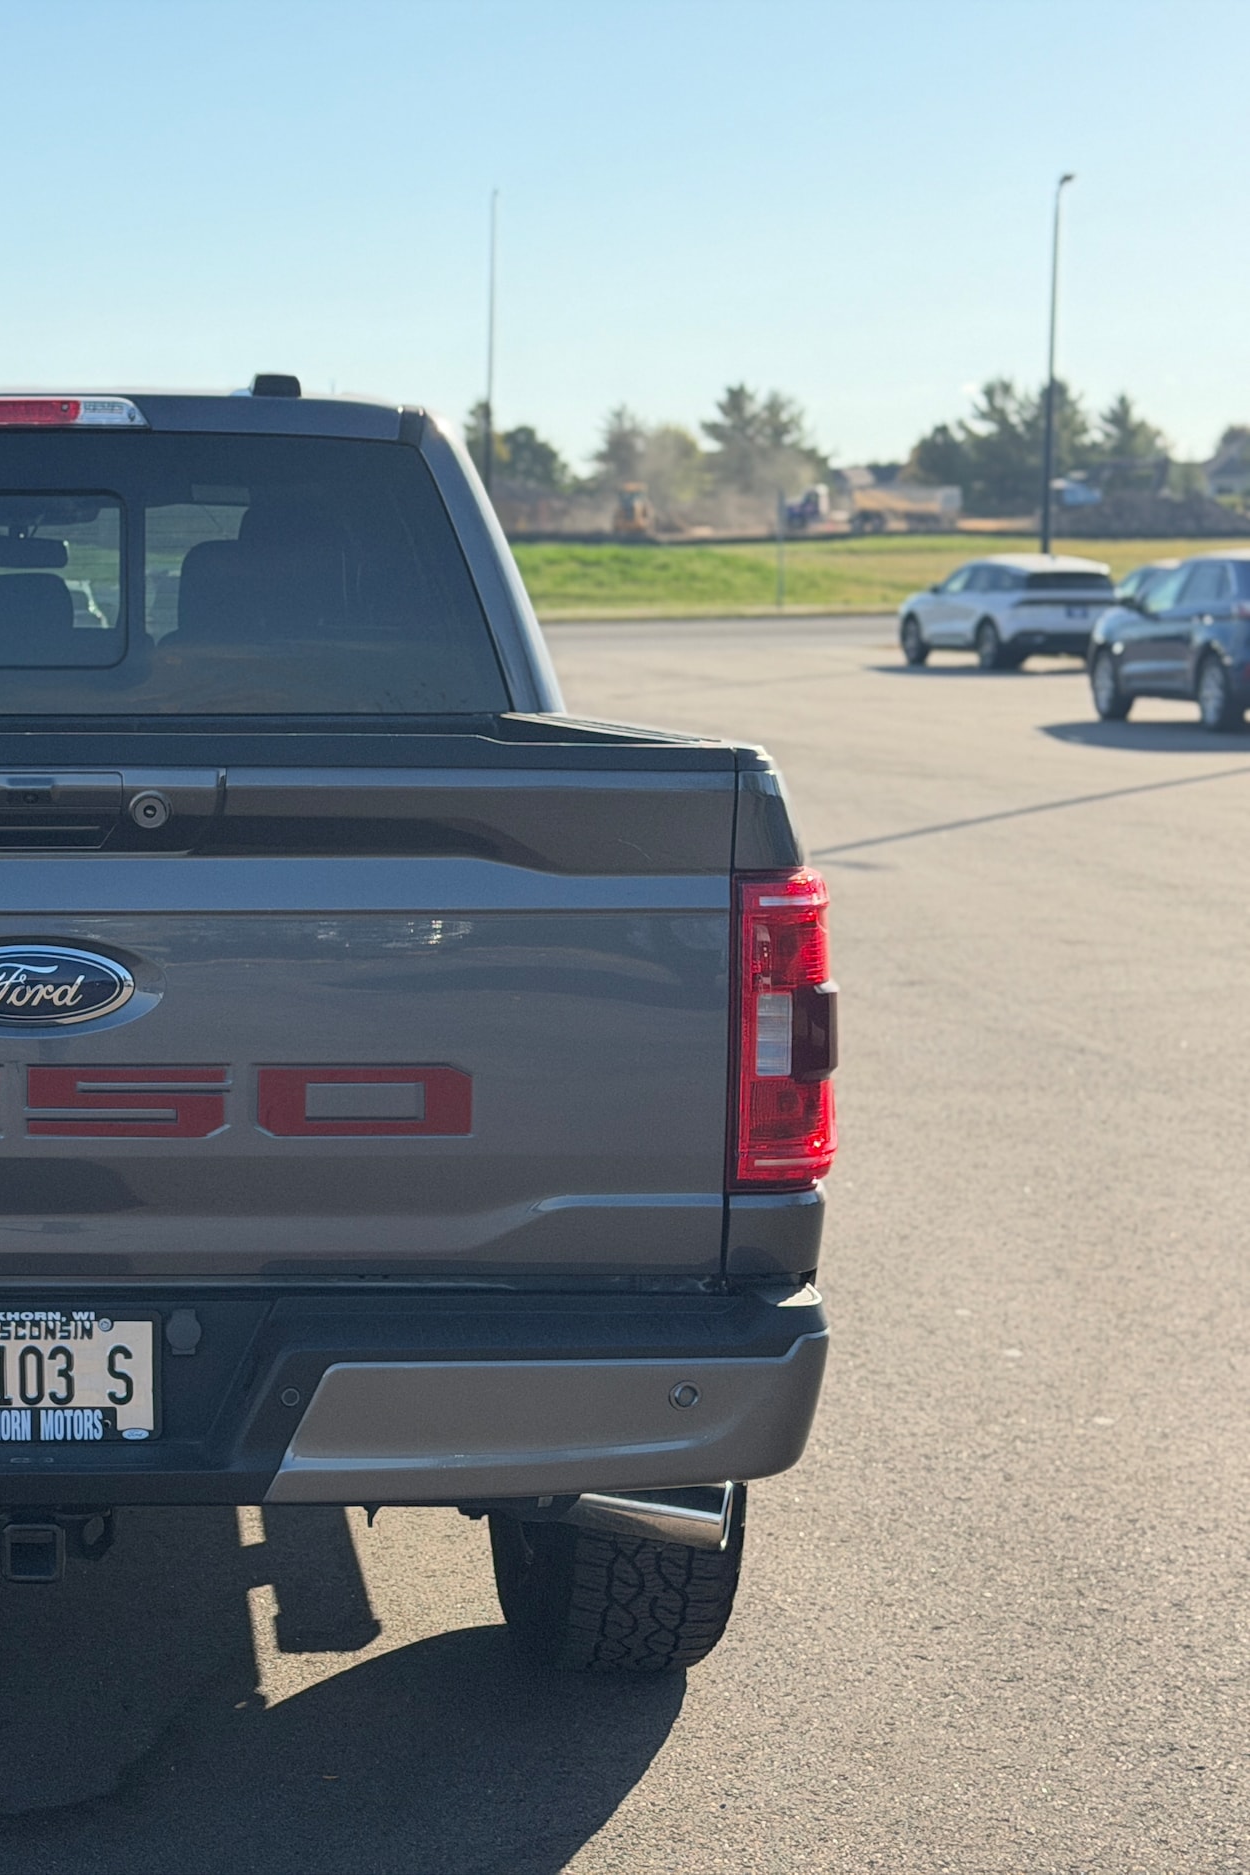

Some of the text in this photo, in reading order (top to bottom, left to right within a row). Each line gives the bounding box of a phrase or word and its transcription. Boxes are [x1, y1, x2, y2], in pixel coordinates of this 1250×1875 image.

[72, 1311, 95, 1321] WI
[106, 1344, 133, 1406] S
[40, 1409, 103, 1441] MOTORS
